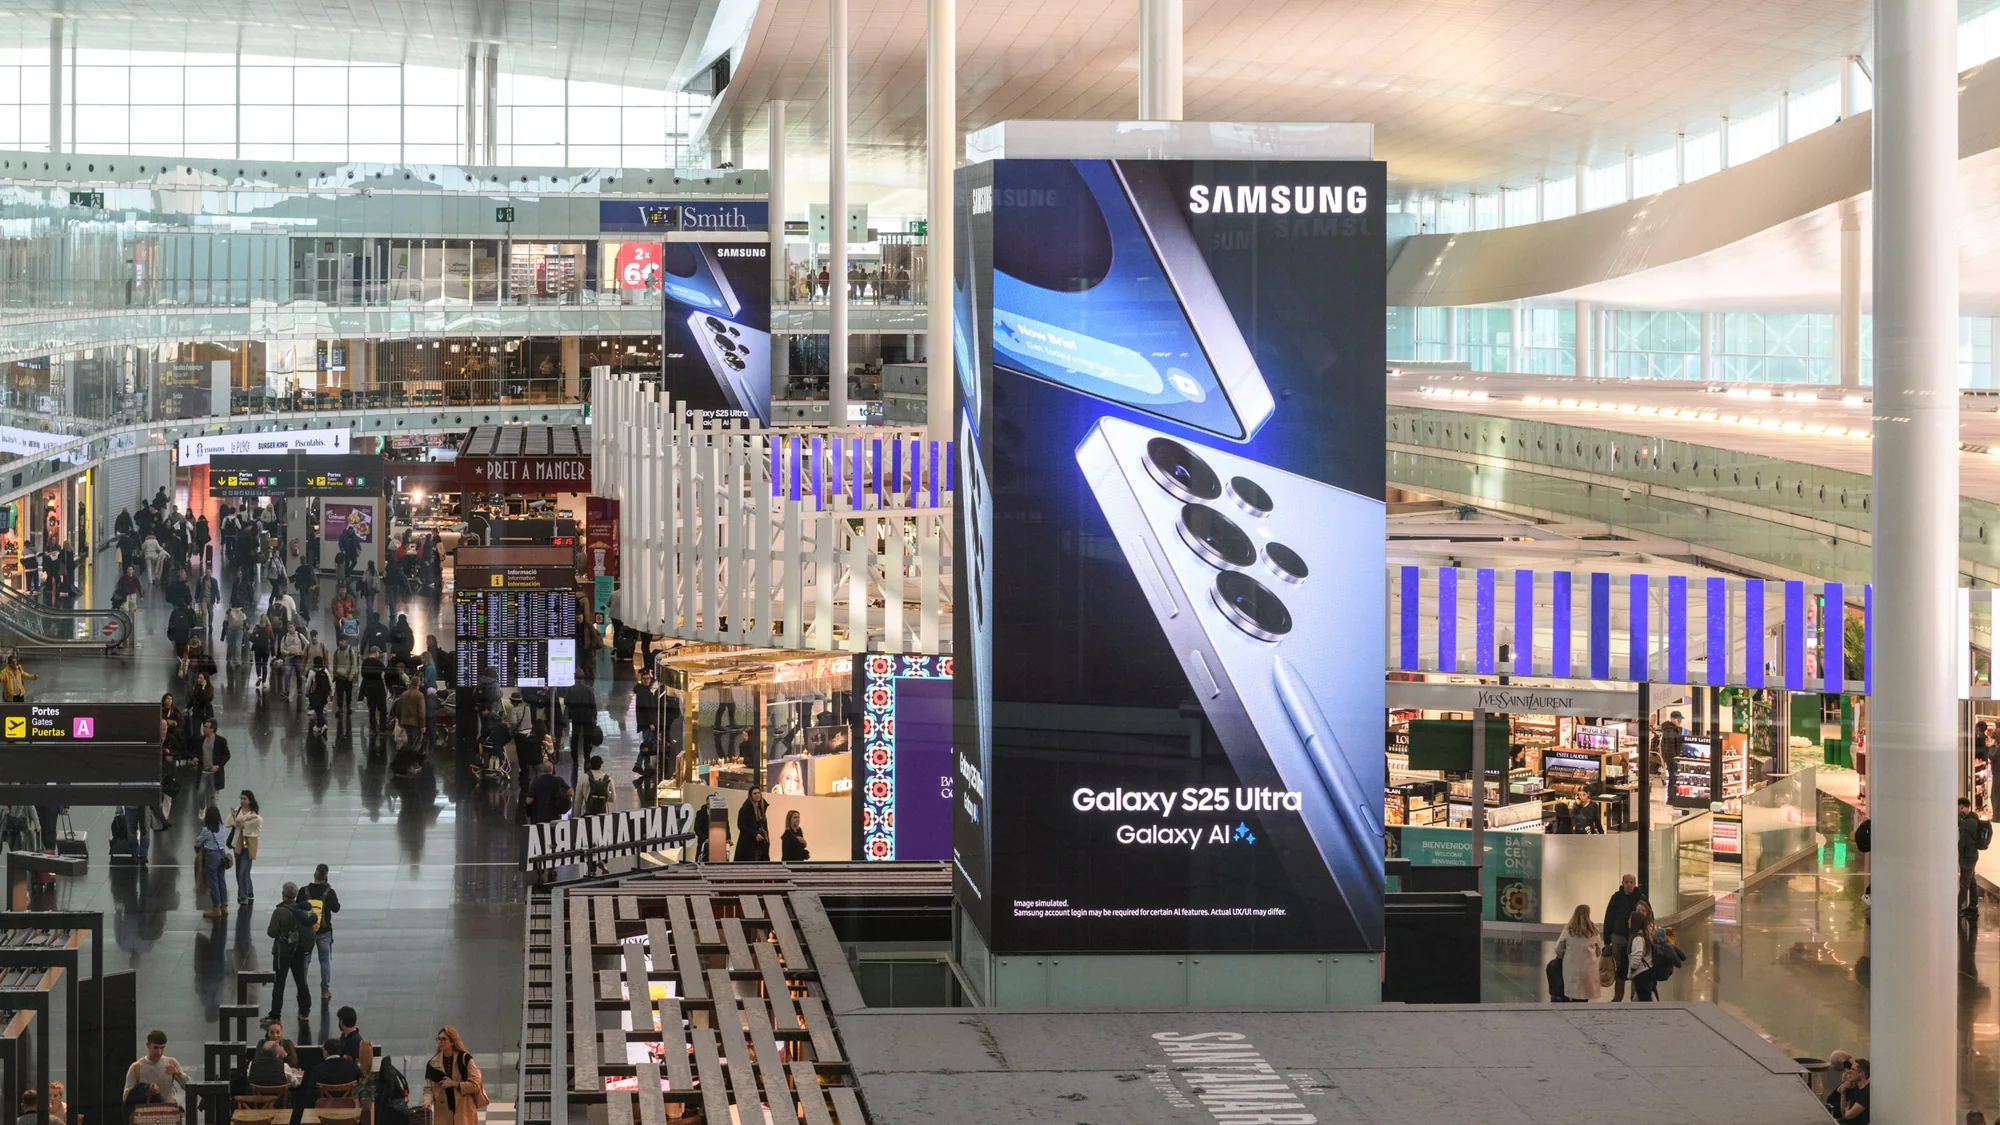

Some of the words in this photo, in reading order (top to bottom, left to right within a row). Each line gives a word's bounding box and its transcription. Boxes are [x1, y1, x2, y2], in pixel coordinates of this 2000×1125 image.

[1189, 184, 1368, 214] SAMSUNG
[717, 248, 767, 258] SAMSUNG
[258, 442, 276, 450] BURGER
[276, 441, 288, 449] KING
[295, 438, 326, 448] Piscolabis.
[487, 460, 517, 480] PRET
[522, 461, 530, 480] A
[536, 460, 585, 480] MANGER
[554, 538, 573, 546] 16:15
[32, 706, 60, 716] Portes
[32, 717, 53, 727] Gates
[77, 719, 90, 736] A
[32, 727, 66, 738] Puertas
[1072, 787, 1177, 817] Galaxy
[1181, 787, 1230, 811] S25
[1235, 786, 1302, 811] Ultra
[1116, 824, 1203, 850] Galaxy
[1208, 824, 1231, 844] AI
[1013, 900, 1035, 909] Image
[1035, 899, 1069, 908] simulated.
[1013, 908, 1044, 918] Samsung
[1044, 909, 1070, 917] account
[1071, 908, 1088, 918] login
[1088, 909, 1103, 918] may
[1103, 908, 1112, 916] be
[1112, 908, 1140, 918] required
[1140, 908, 1150, 916] for
[1150, 908, 1173, 916] certain
[1181, 908, 1210, 916] features.
[1210, 908, 1232, 916] Actual
[1232, 908, 1252, 916] UX/UI
[1252, 909, 1268, 918] may
[1267, 907, 1287, 916] differ.
